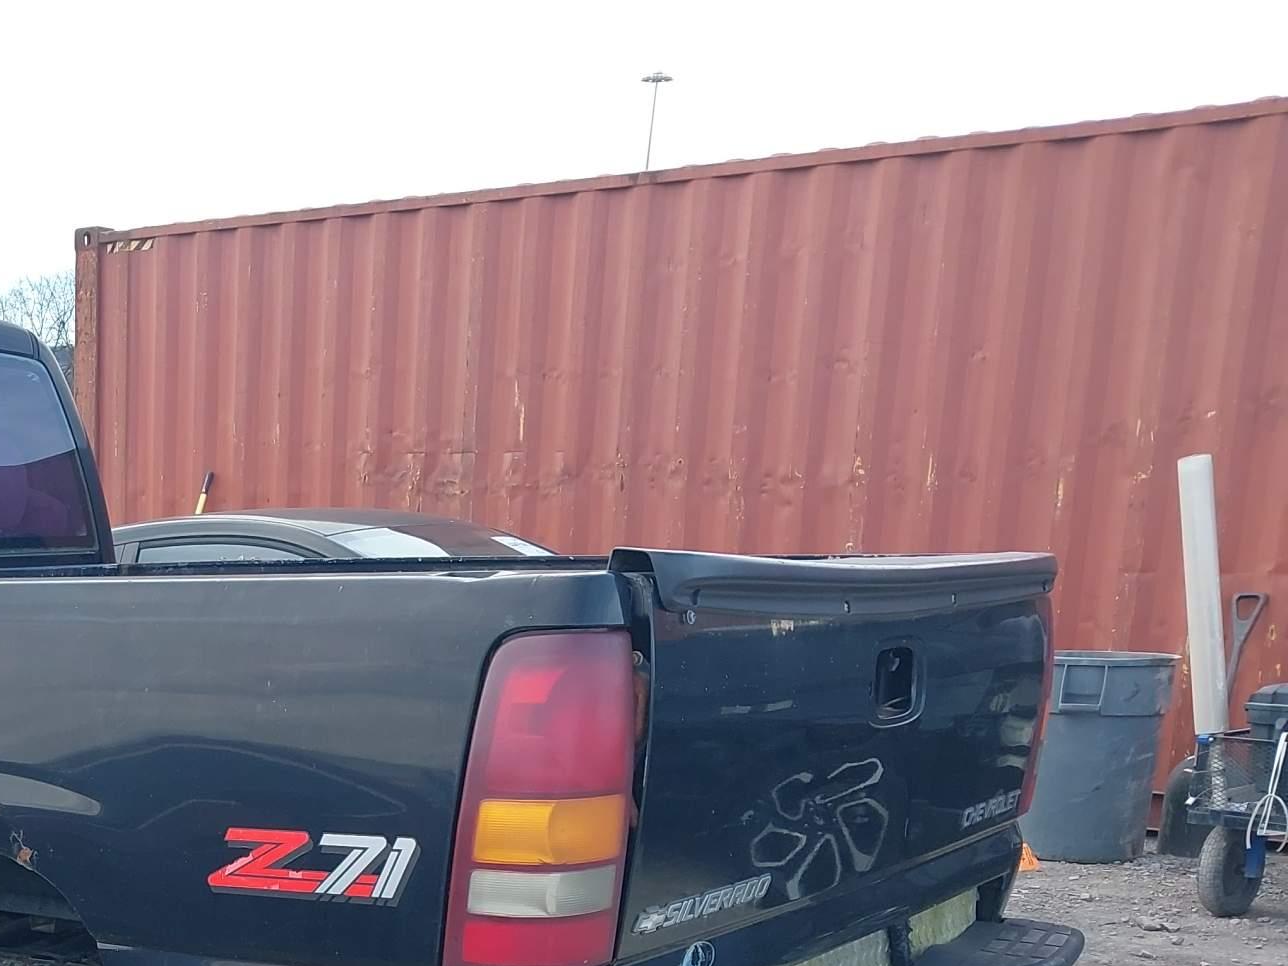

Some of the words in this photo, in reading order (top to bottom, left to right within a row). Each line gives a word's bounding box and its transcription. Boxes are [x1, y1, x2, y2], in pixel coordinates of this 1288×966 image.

[960, 789, 1022, 829] CHEVROLET
[207, 827, 420, 907] Z71
[662, 873, 772, 928] SILVERADO
